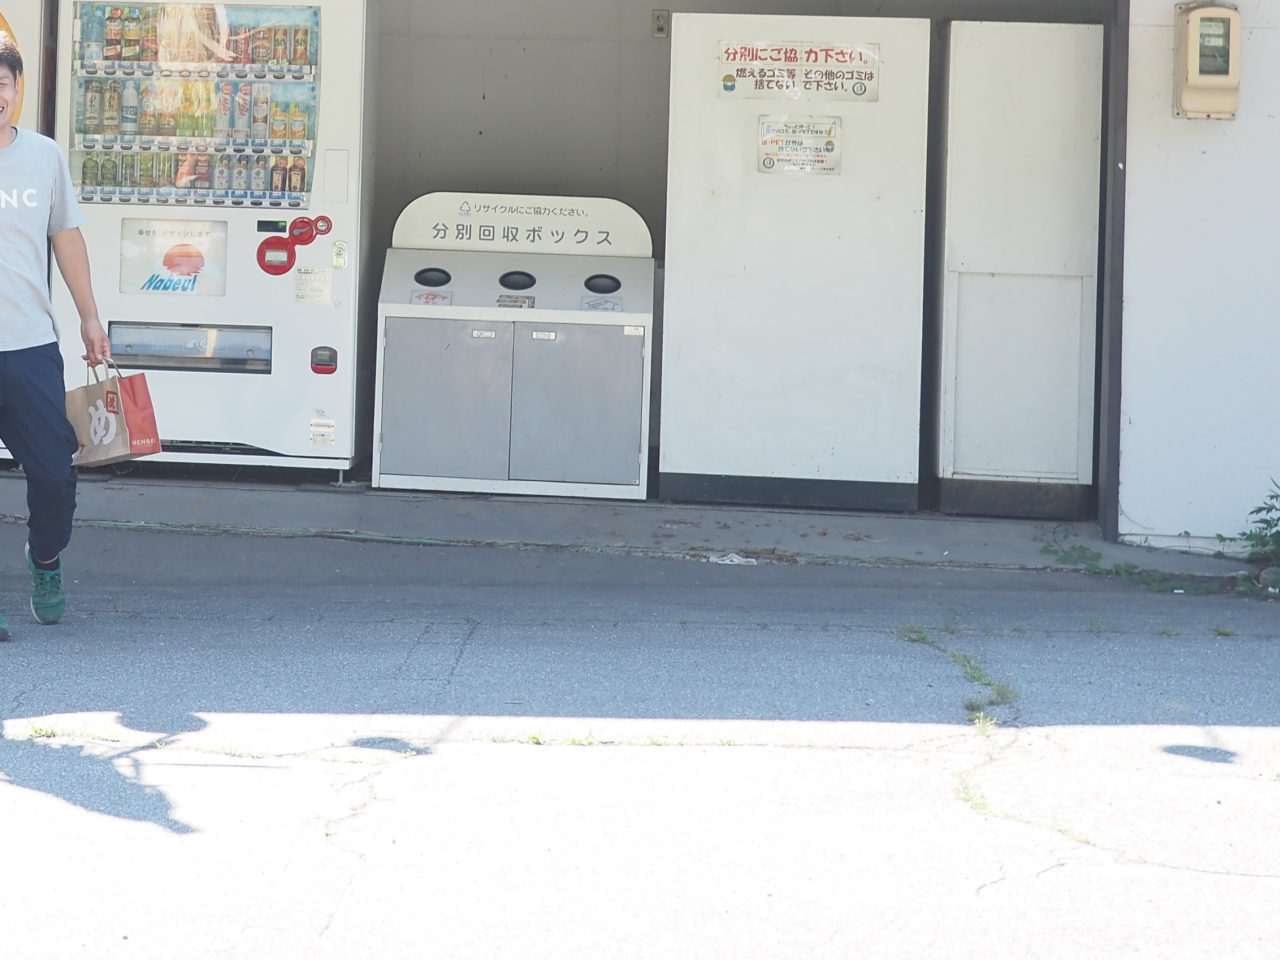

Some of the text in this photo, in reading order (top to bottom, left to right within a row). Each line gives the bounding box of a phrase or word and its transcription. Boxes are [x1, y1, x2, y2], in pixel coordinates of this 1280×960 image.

[474, 204, 589, 217] リサイクルにご協力ください。
[432, 222, 613, 246] 分別回収ボックス
[140, 274, 198, 291] Nabeul
[88, 399, 117, 446] め
